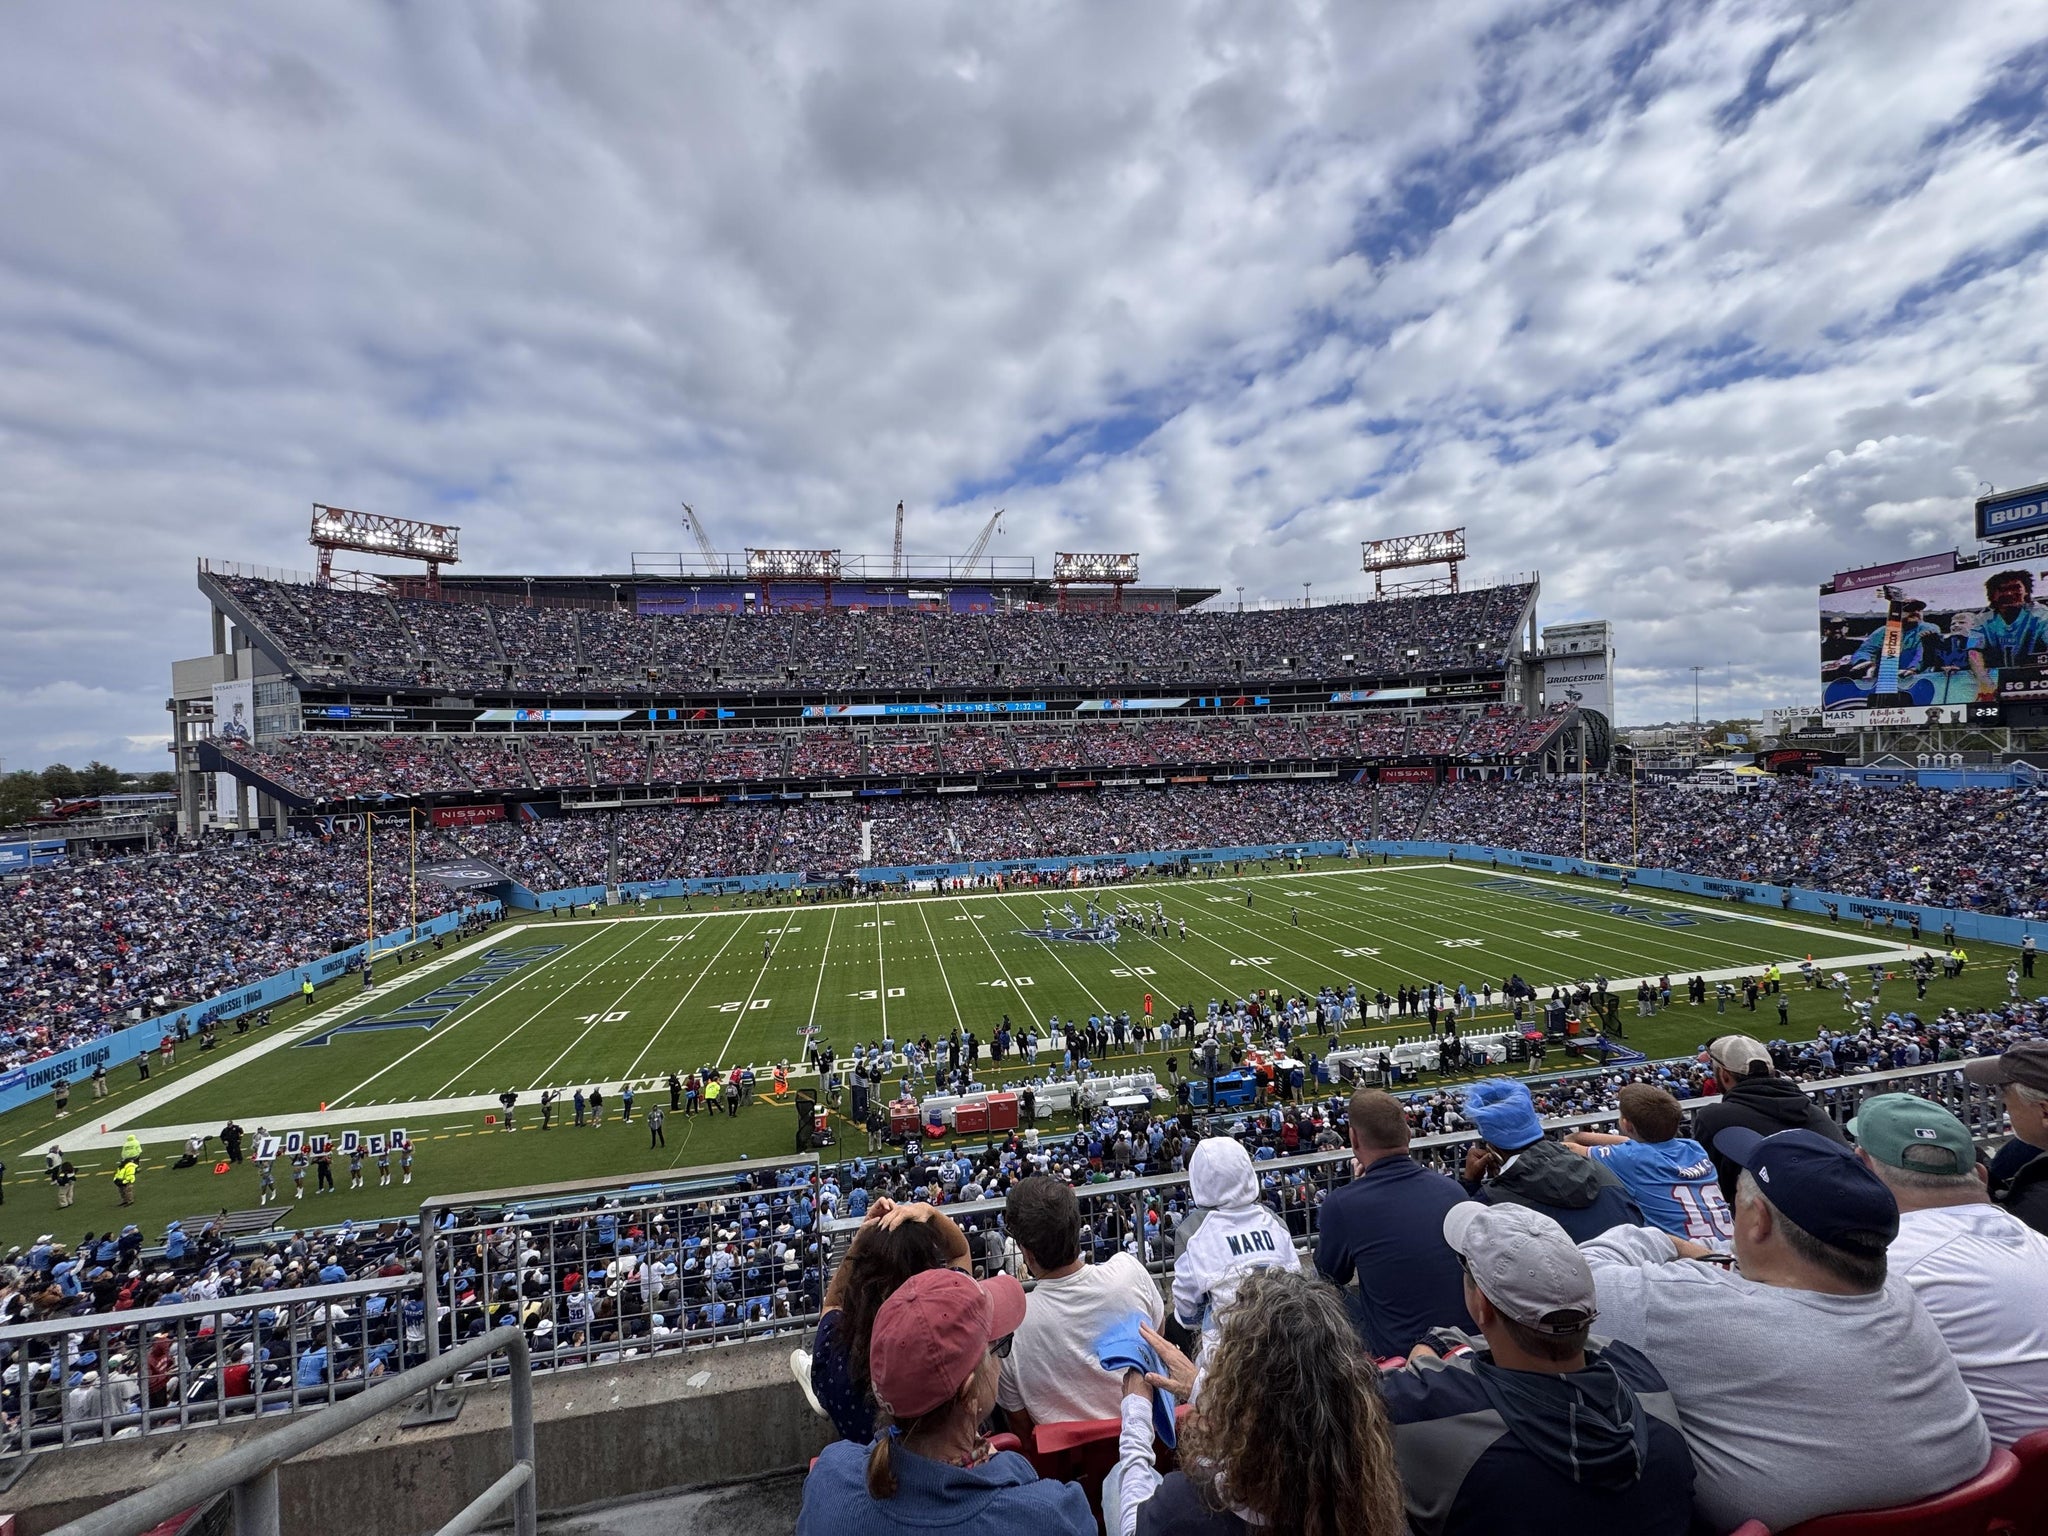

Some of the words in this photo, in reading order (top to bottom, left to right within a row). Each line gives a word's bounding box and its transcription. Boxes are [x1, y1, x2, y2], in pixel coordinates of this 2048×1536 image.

[1991, 504, 2039, 525] BUD
[1981, 542, 2048, 564] Pinnacle
[1856, 573, 1890, 583] Ascension
[1891, 568, 1910, 577] Saint
[1910, 563, 1941, 573] Thomas
[1886, 630, 1898, 660] verizon
[1546, 674, 1605, 684] BRIDGESTONE
[2005, 682, 2024, 690] 5G
[1015, 703, 1031, 711] 2:32
[1773, 708, 1822, 717] NISSA
[1976, 707, 1998, 717] 2:32
[1825, 711, 1856, 720] MARS
[441, 808, 496, 819] NISSAN
[384, 814, 410, 828] Kroger
[1230, 956, 1273, 967] 40
[1110, 966, 1157, 978] 50
[990, 976, 1035, 988] 40
[859, 987, 906, 1000] 30
[719, 998, 773, 1013] 20
[583, 1010, 632, 1024] 10
[26, 1058, 78, 1091] TENNESSEE
[81, 1045, 111, 1069] TOUGH
[260, 1130, 404, 1158] LOUDER
[907, 1144, 919, 1154] 22
[943, 1169, 955, 1180] 22
[1672, 1182, 1735, 1239] 16
[335, 1234, 345, 1246] 8
[1226, 1230, 1276, 1257] WARD
[186, 1381, 205, 1398] 11
